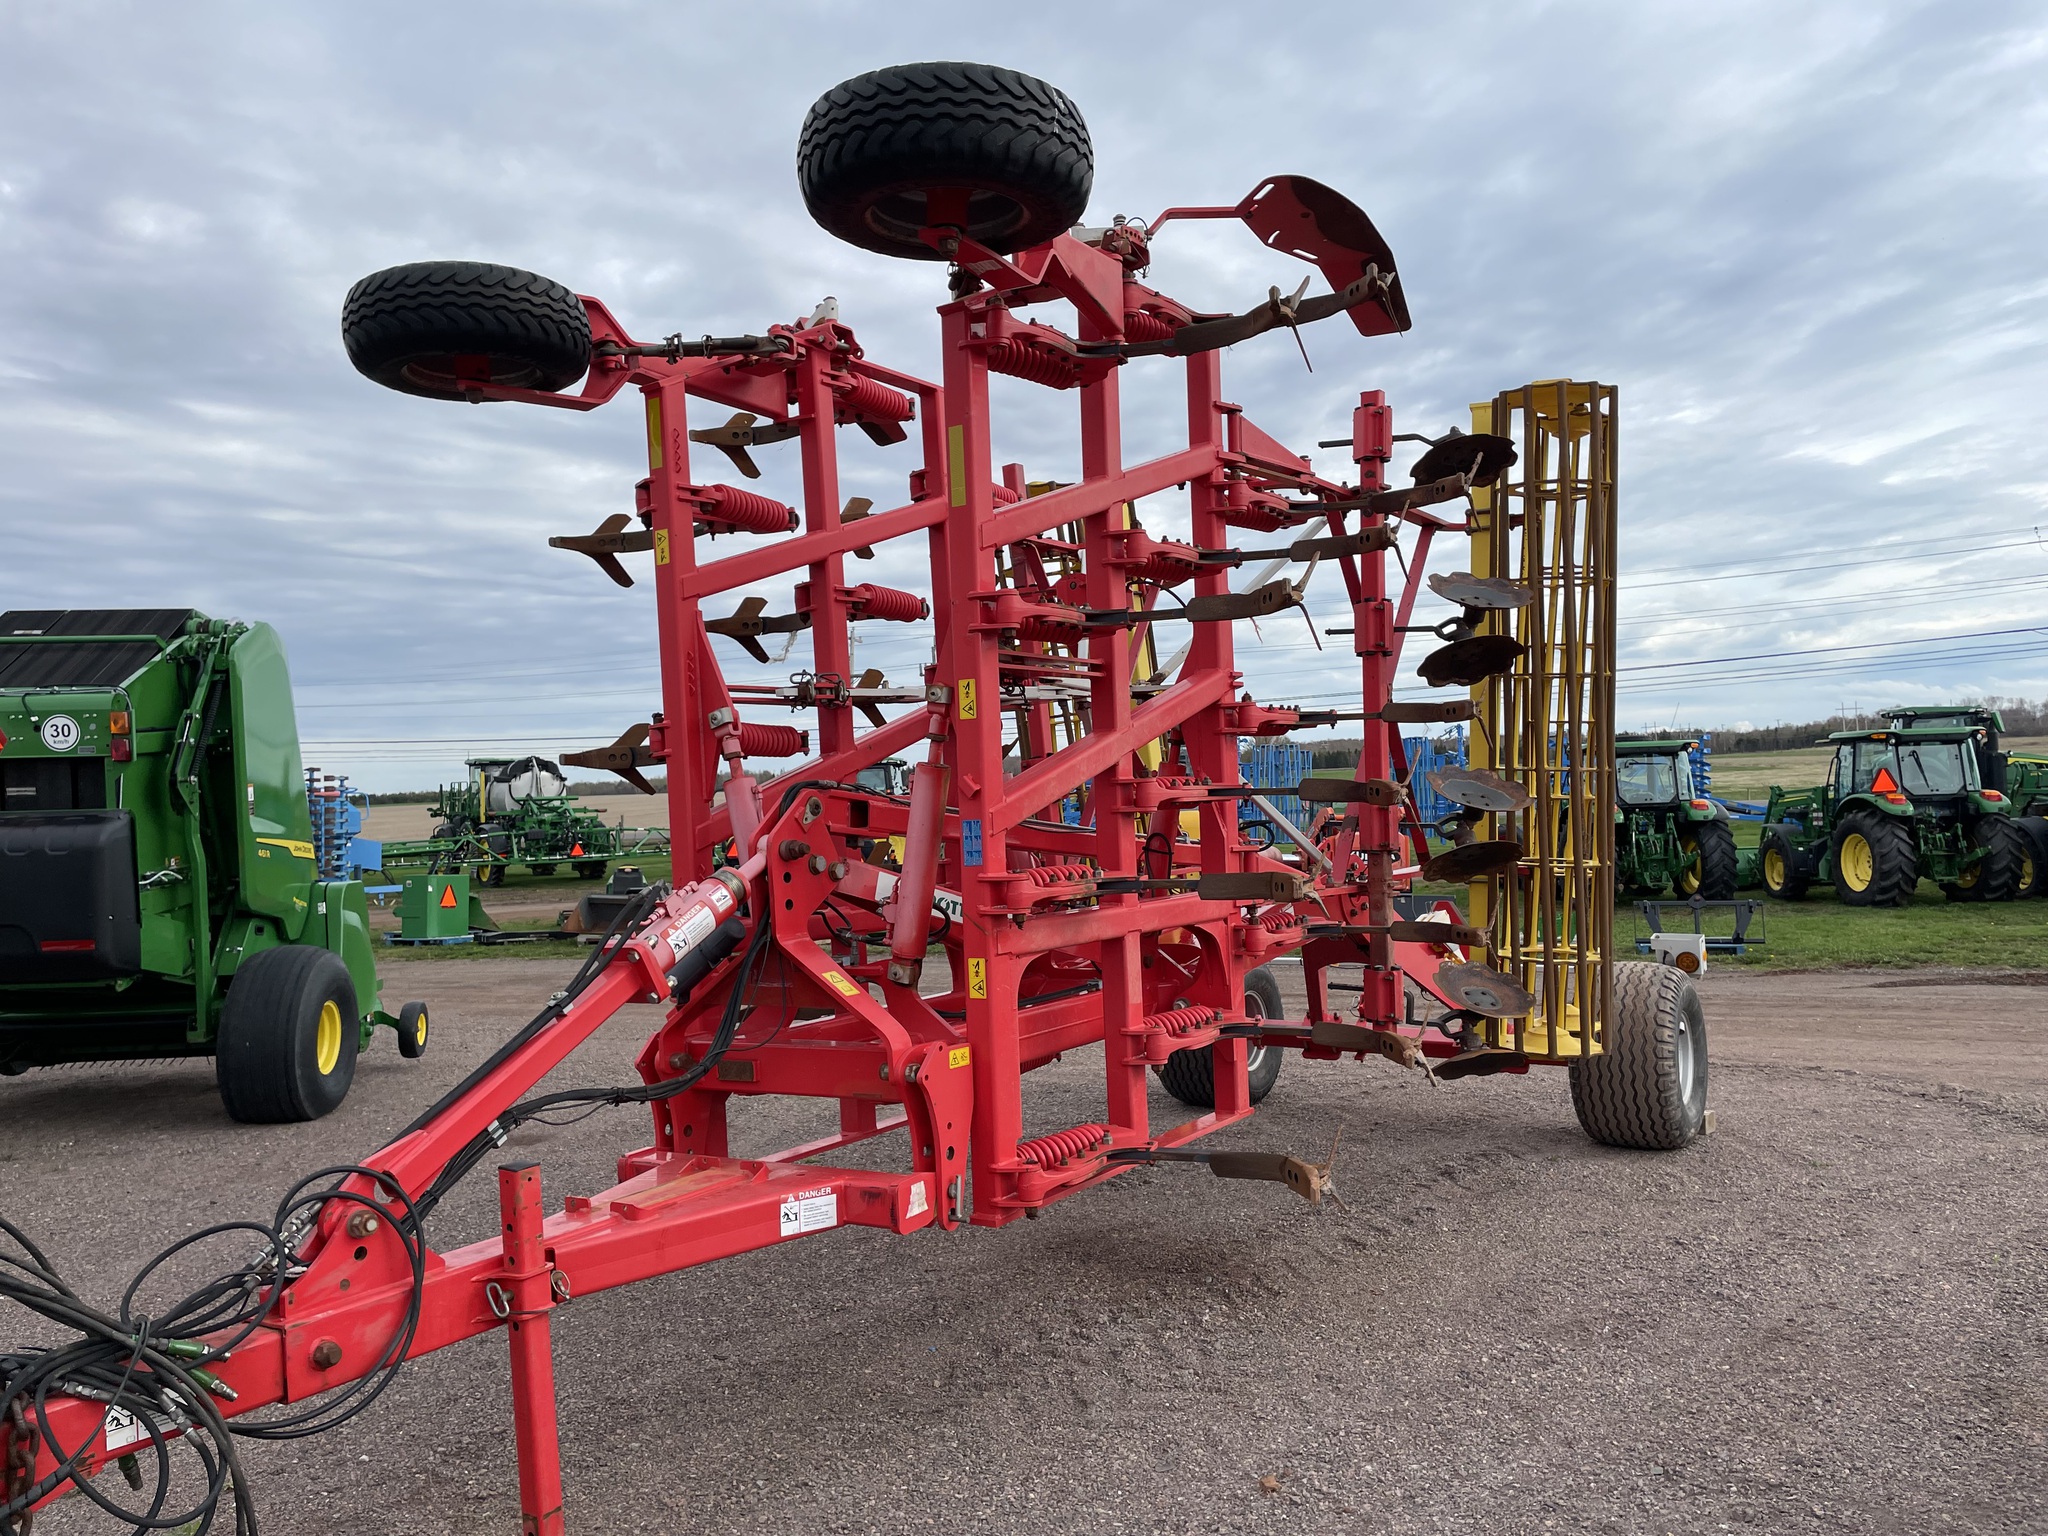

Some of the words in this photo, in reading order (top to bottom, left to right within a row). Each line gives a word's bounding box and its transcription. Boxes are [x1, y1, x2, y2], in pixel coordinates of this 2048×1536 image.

[50, 723, 71, 738] 30
[674, 904, 702, 928] DANGER
[798, 1186, 832, 1200] DANGER
